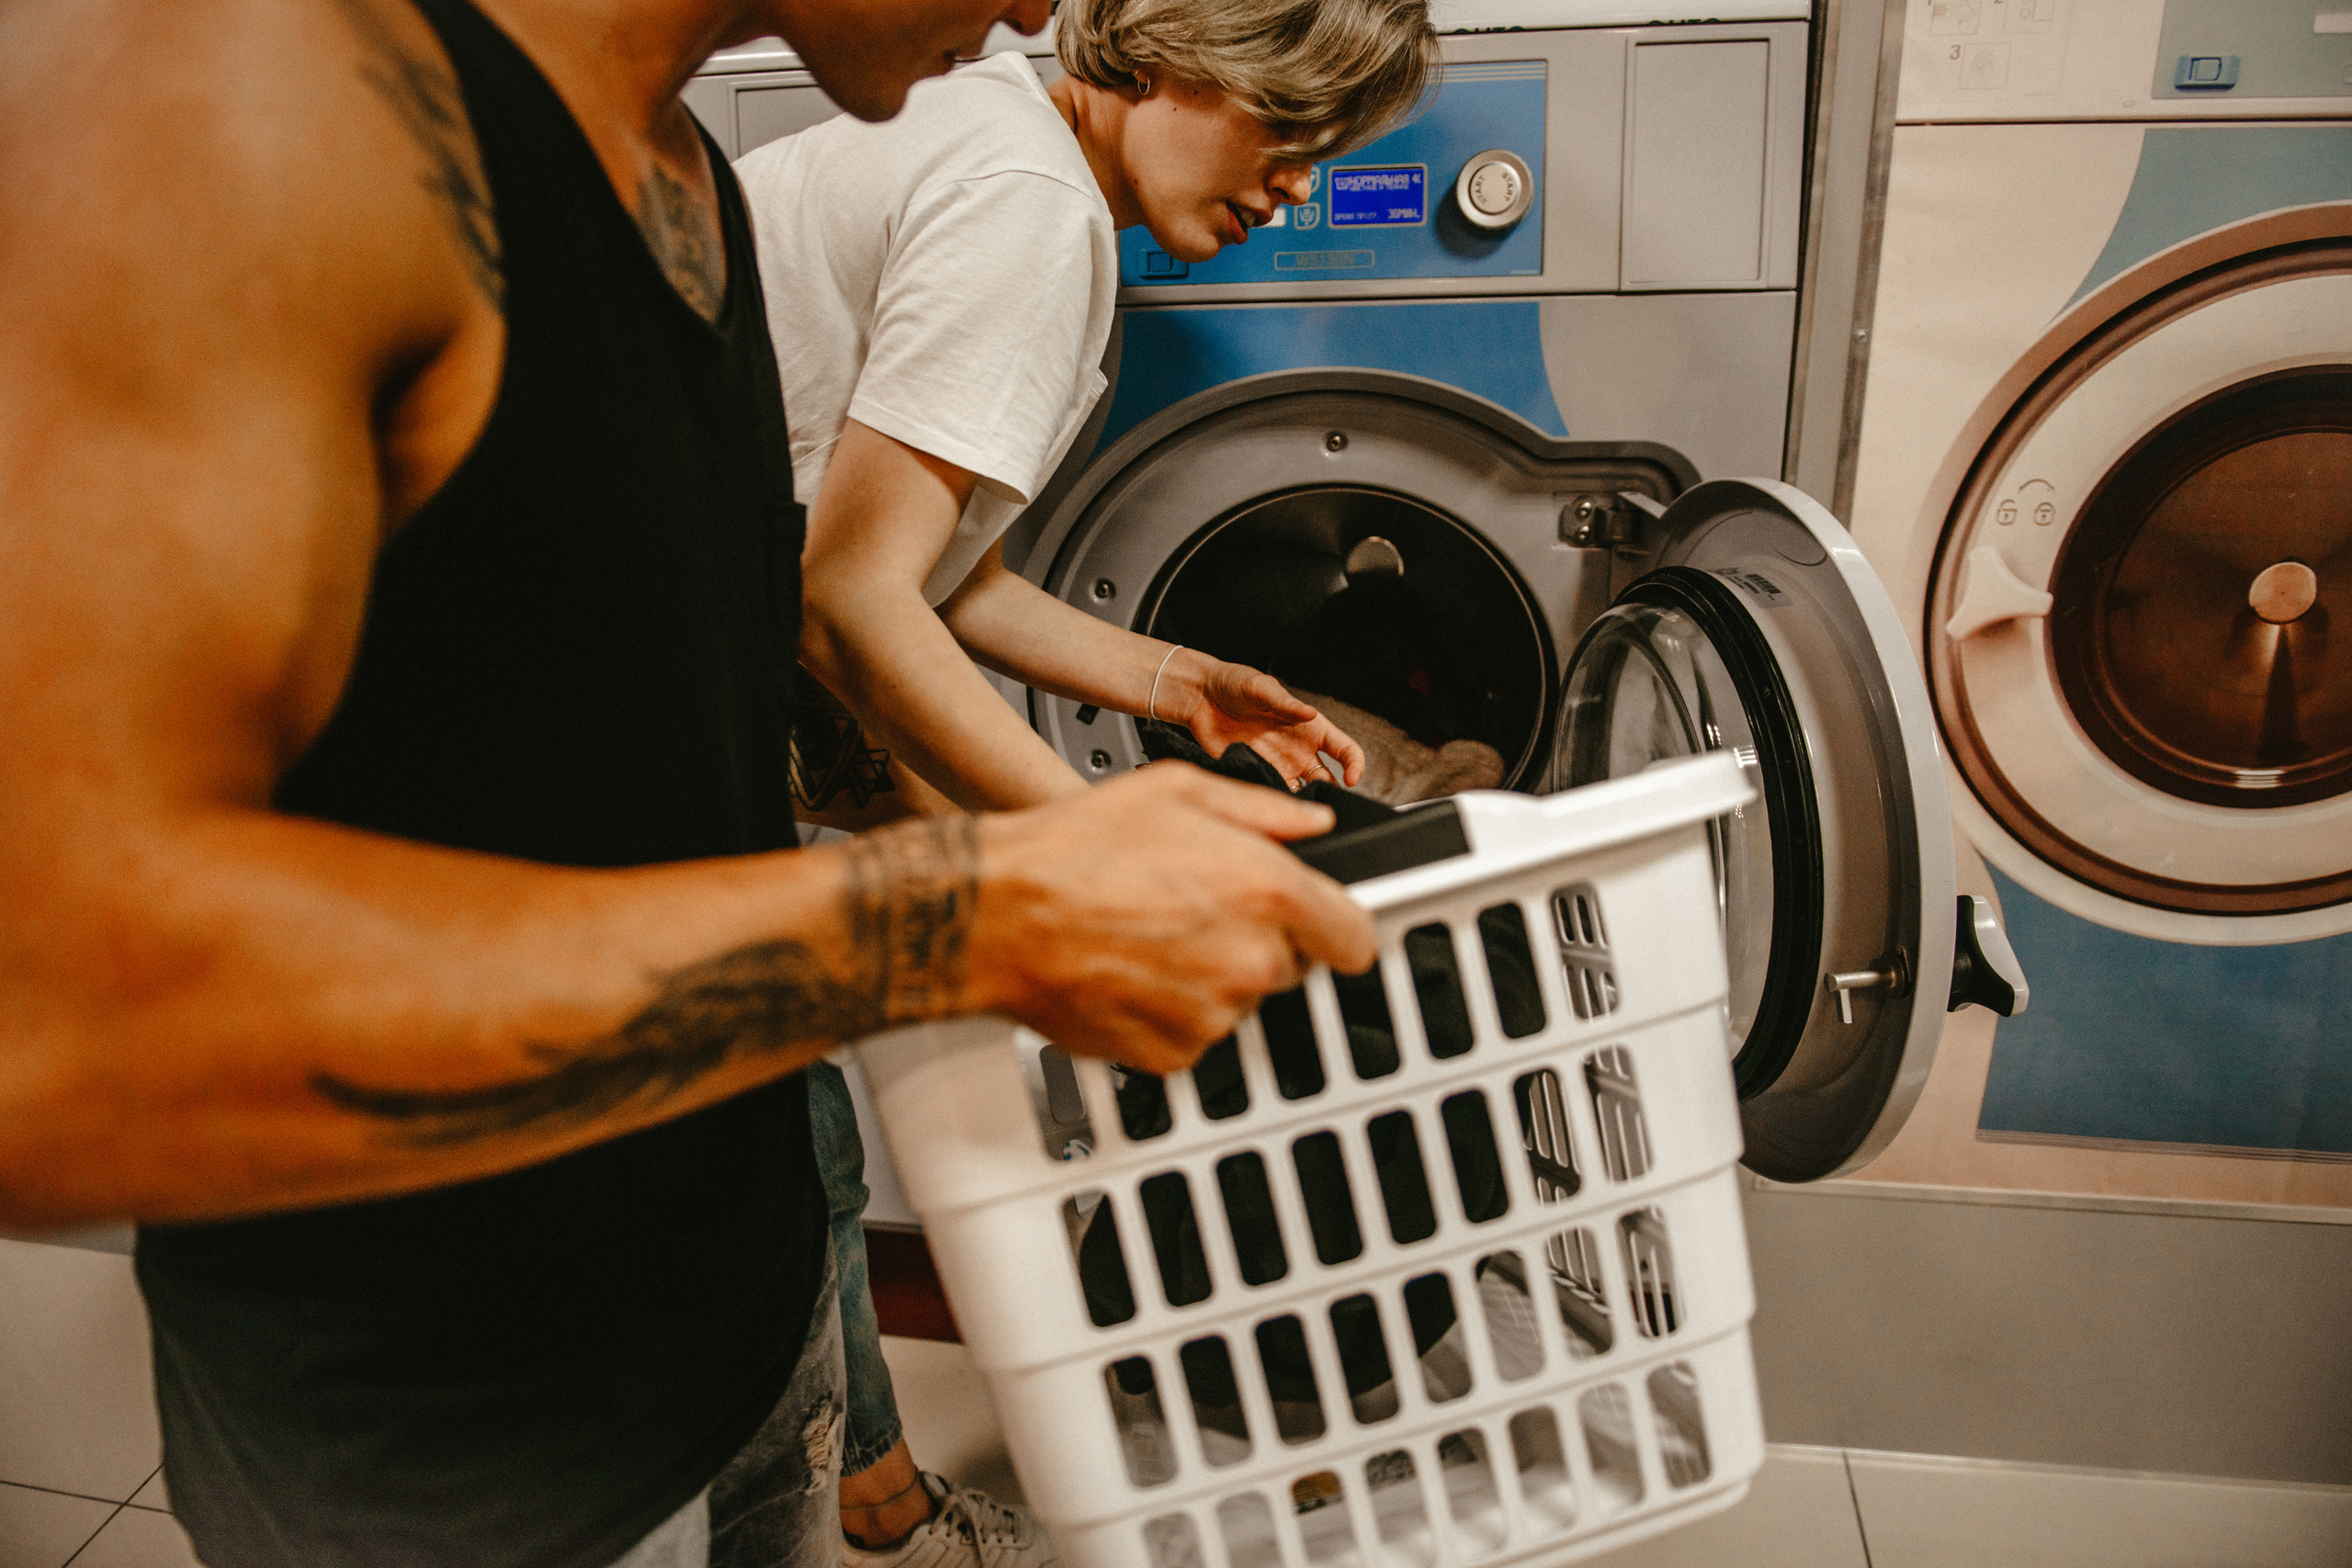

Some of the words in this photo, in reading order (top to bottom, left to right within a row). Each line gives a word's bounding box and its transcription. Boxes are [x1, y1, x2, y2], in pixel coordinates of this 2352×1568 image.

[1950, 45, 1961, 60] 3
[1475, 175, 1487, 204] START
[1501, 172, 1514, 201] START
